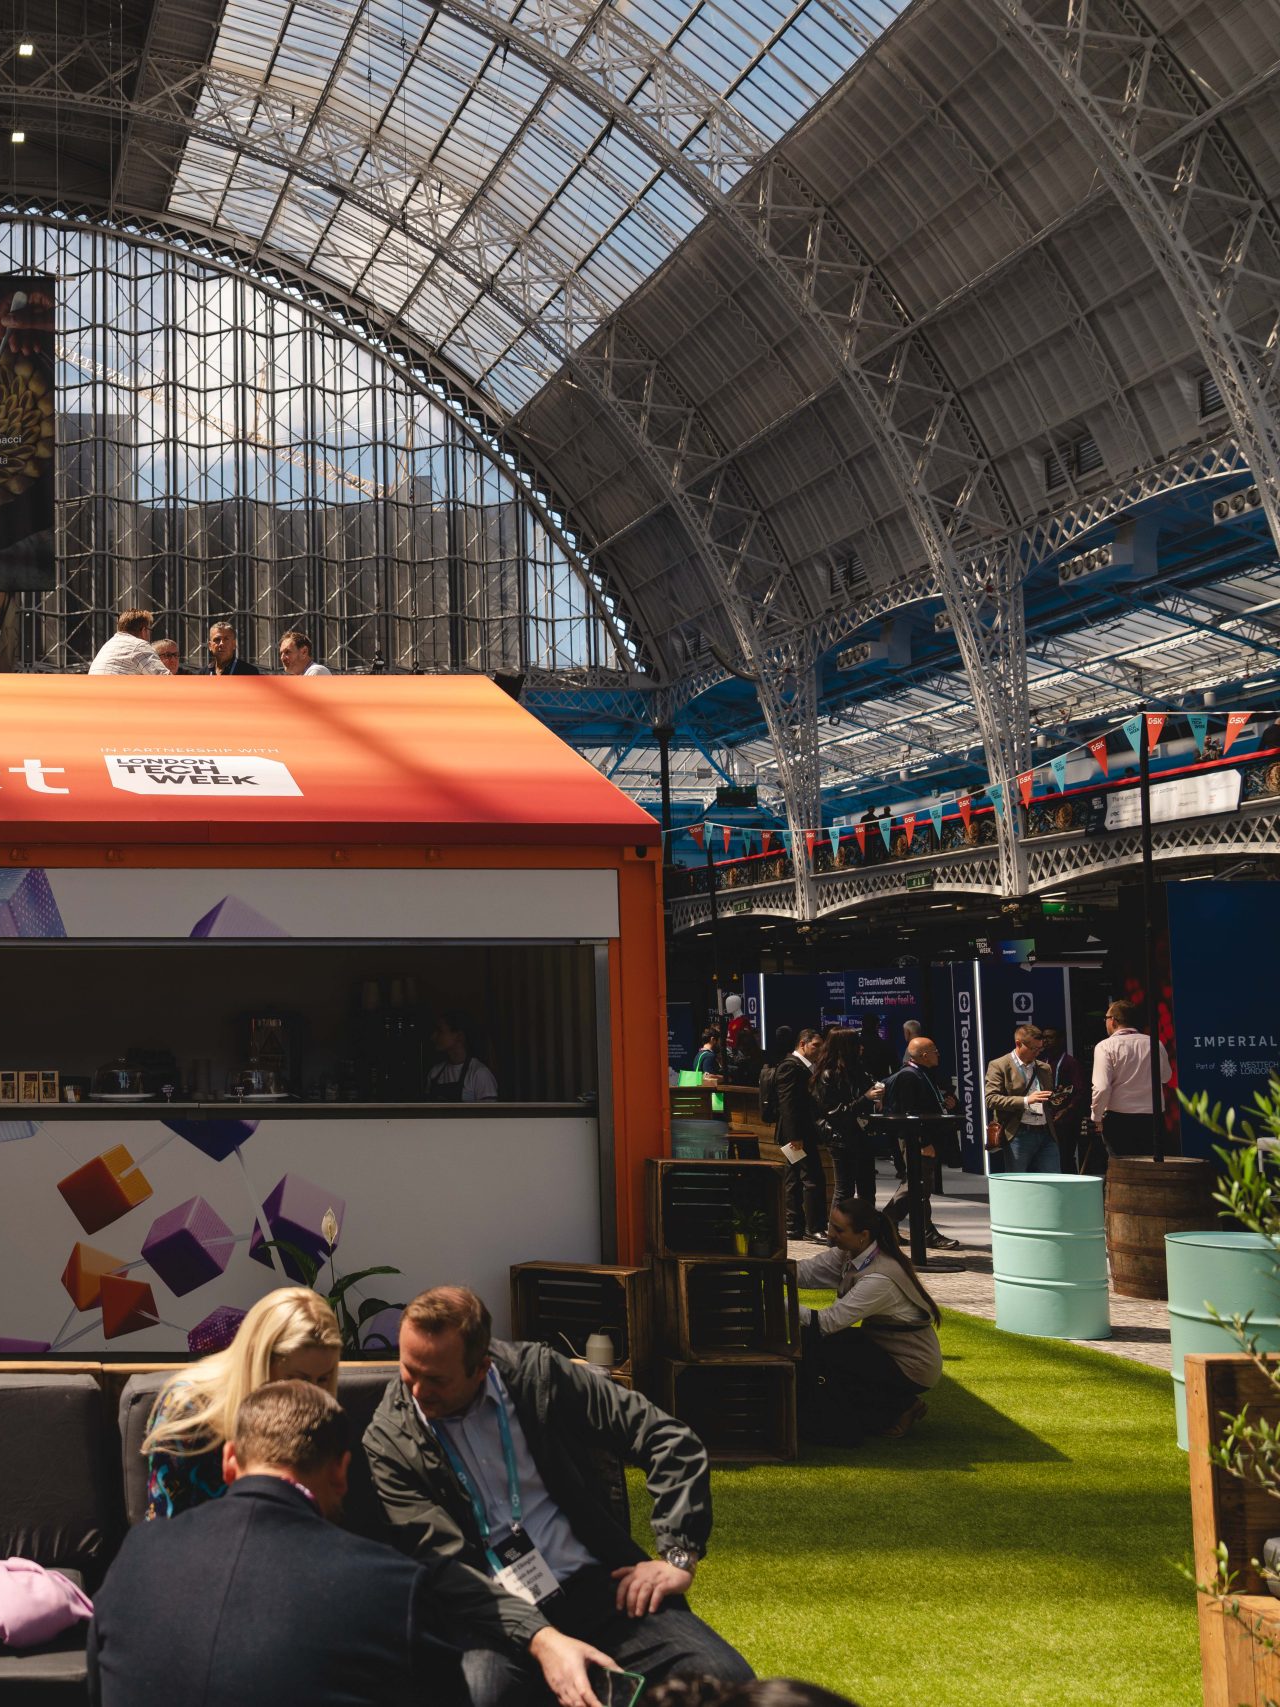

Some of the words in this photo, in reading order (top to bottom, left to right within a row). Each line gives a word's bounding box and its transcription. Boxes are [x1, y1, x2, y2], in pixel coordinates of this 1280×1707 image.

[1147, 717, 1163, 725] GSK
[1091, 741, 1104, 752] GSK
[118, 765, 220, 775] TECH
[147, 775, 260, 786] WEEK
[1020, 774, 1031, 784] GSK
[864, 977, 893, 986] TeamViewer
[894, 976, 906, 985] ONE
[851, 996, 860, 1006] Fix
[865, 995, 883, 1005] before
[884, 995, 897, 1007] they
[1193, 1035, 1278, 1048] IMPERIAL
[1209, 1062, 1216, 1070] of
[960, 1014, 975, 1144] TeamViewer
